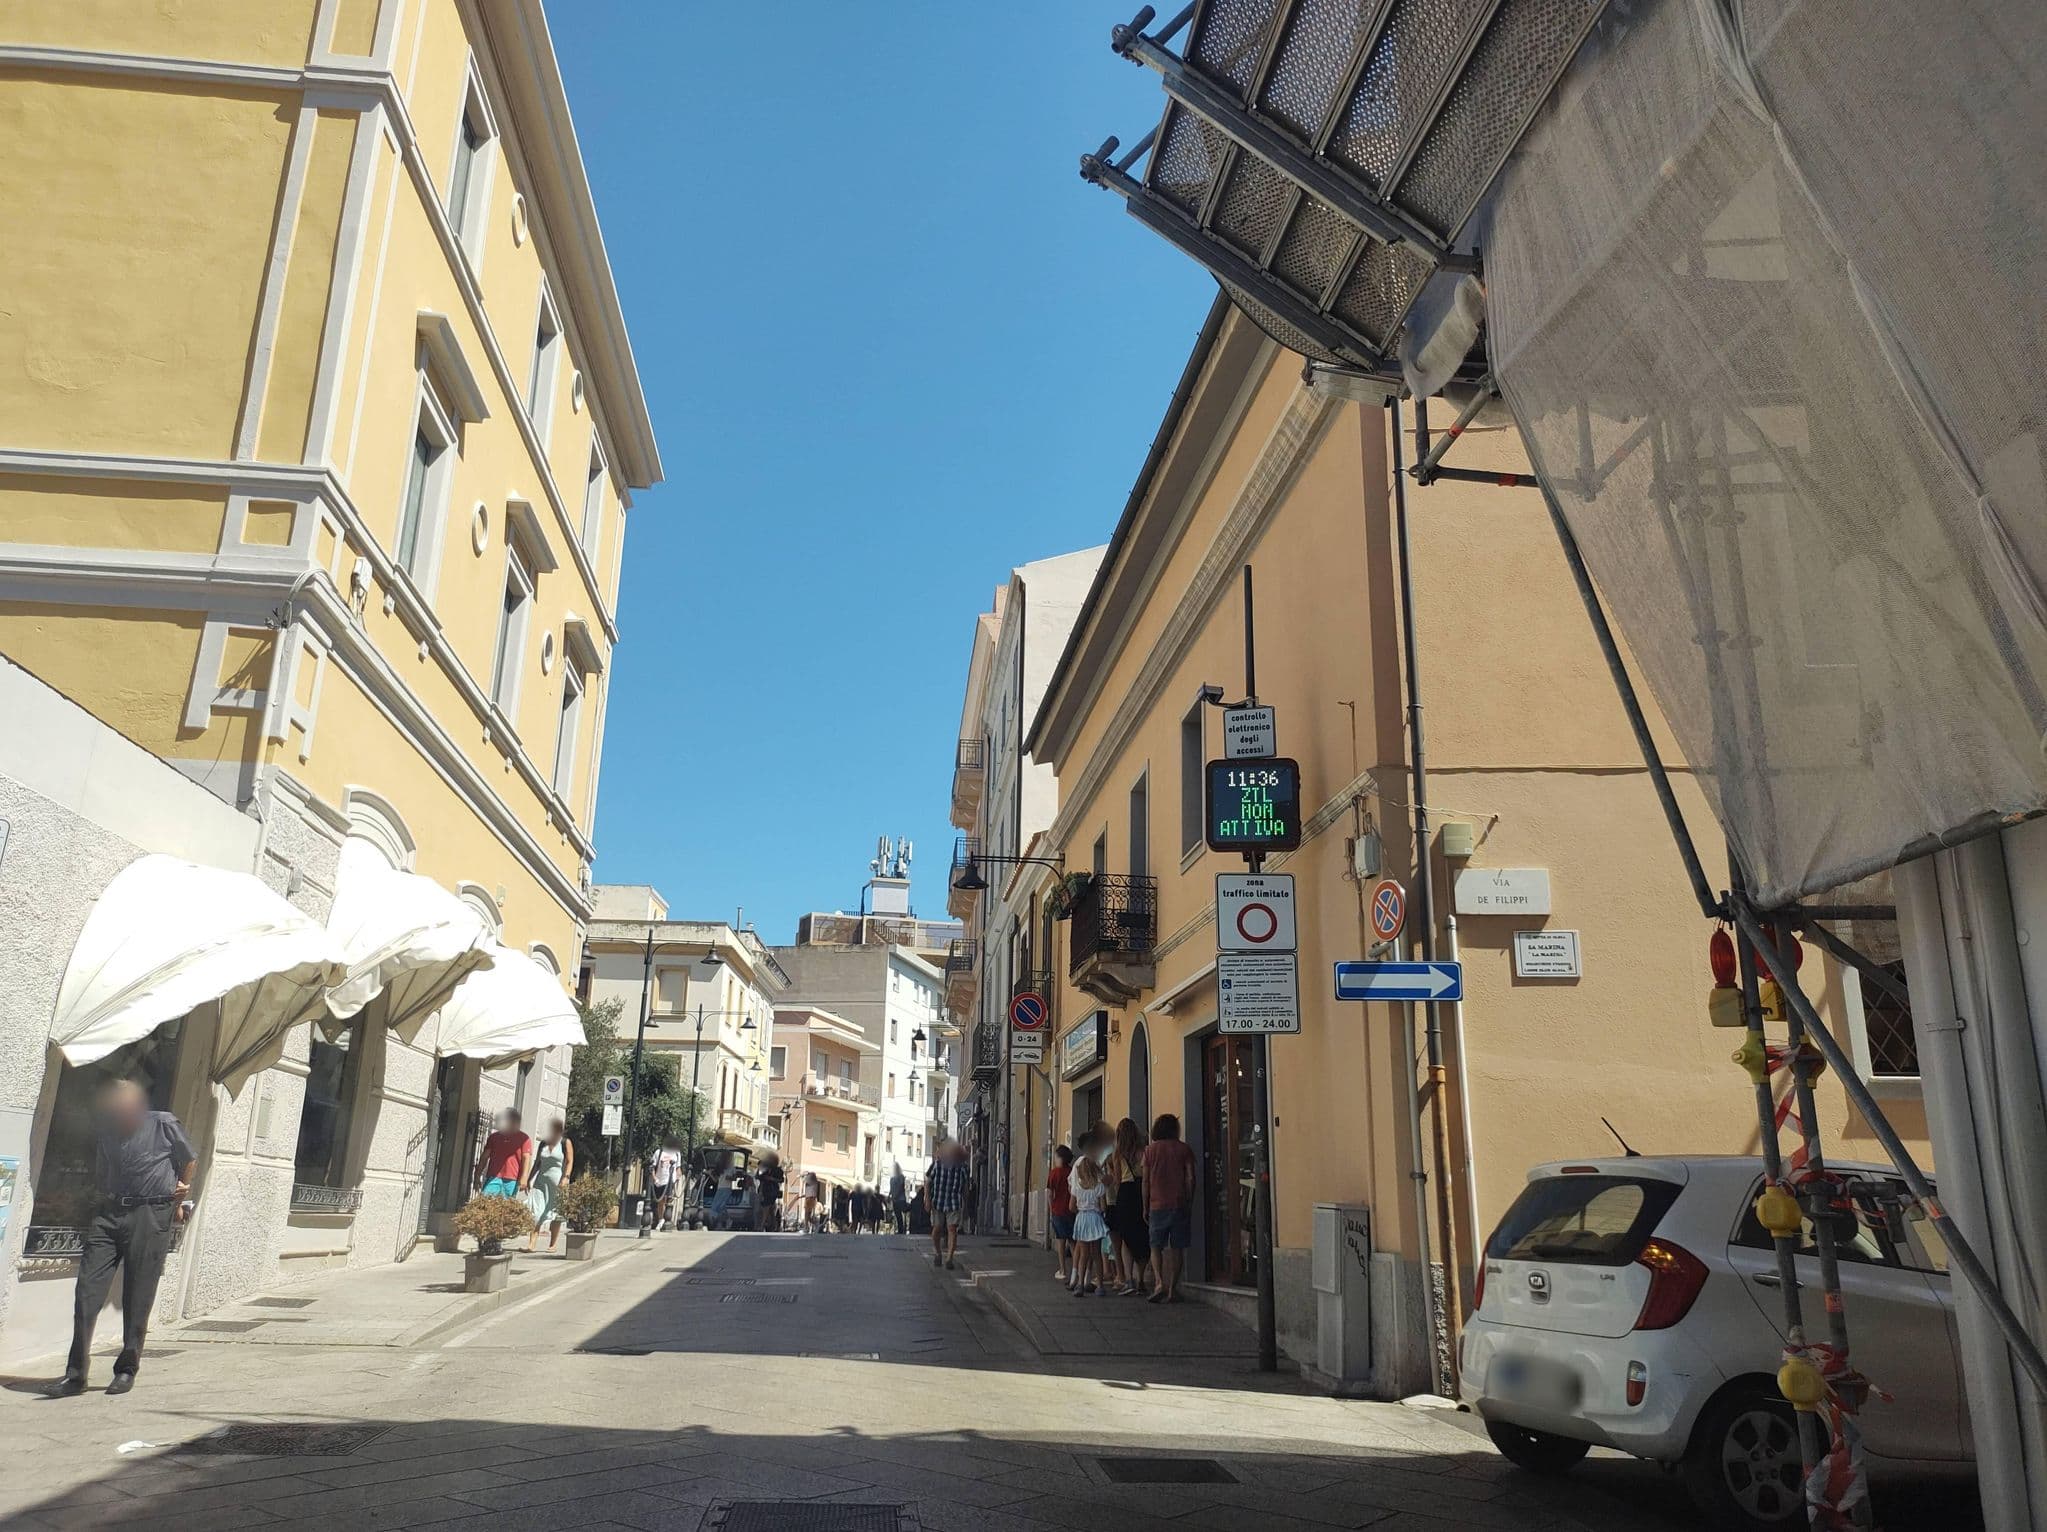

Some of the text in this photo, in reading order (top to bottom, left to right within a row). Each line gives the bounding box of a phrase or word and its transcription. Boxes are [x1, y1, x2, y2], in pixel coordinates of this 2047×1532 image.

[1231, 712, 1266, 722] controllo
[1228, 724, 1270, 733] elettronico
[1228, 770, 1279, 787] 11:36
[1241, 787, 1272, 802] ZTL
[1241, 803, 1273, 819] NON
[1220, 820, 1284, 836] ATTIVA
[1223, 890, 1289, 898] traffico limitato
[1477, 896, 1528, 904] DE FILIPPI
[1226, 1019, 1253, 1029] 17.00
[1263, 1019, 1290, 1029] 24.00
